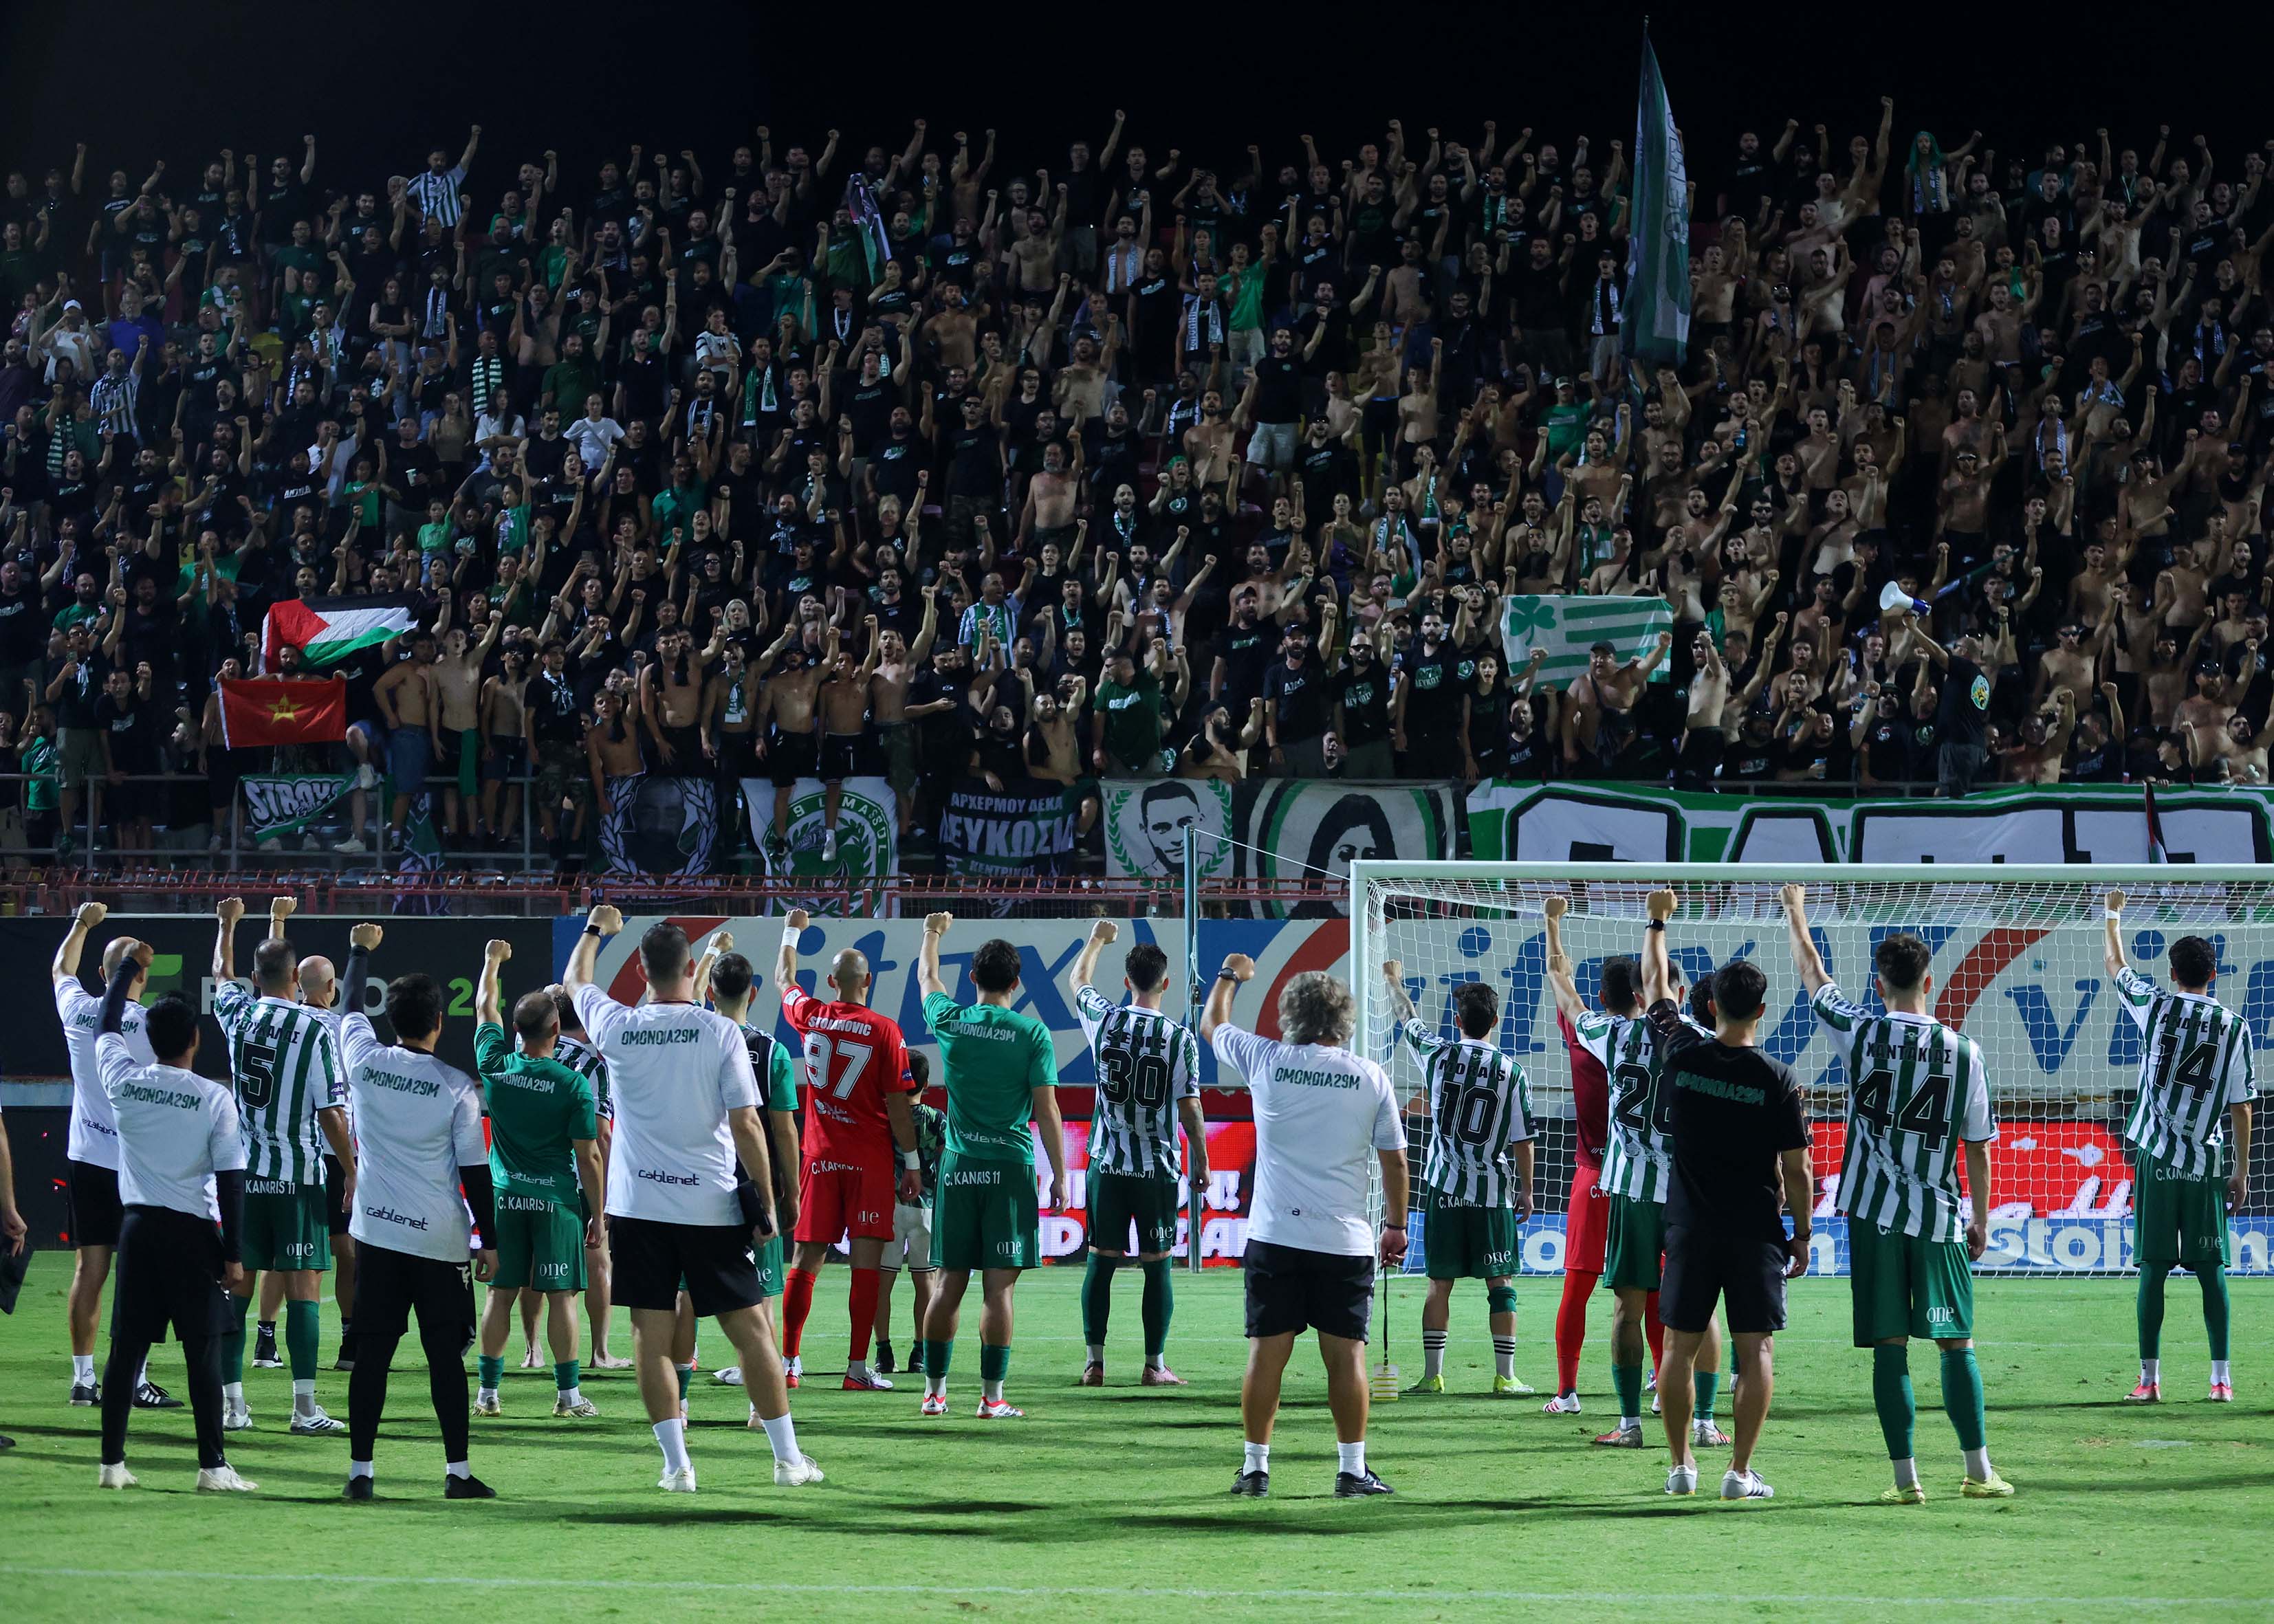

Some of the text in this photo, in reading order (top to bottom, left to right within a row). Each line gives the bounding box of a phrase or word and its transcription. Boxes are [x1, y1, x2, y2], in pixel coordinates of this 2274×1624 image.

[951, 792, 1027, 813] ΑΡΧΕΡΜΟΥ
[818, 796, 886, 855] LMASSOL
[808, 1015, 872, 1037] STOJANOVIC
[949, 1020, 1016, 1042] OMONOIA29M
[621, 1029, 699, 1046] OMONOIA29M
[804, 1029, 873, 1100] 97
[1438, 1059, 1506, 1082] MORAIS
[2151, 1031, 2220, 1103] 14
[239, 1041, 277, 1111] 5
[362, 1066, 441, 1098] OMONOIA29M
[1100, 1046, 1168, 1109] 30
[1274, 1067, 1361, 1090] OMONOIA29M
[122, 1084, 201, 1112] OMONOIA29M
[1675, 1071, 1765, 1106] OMONOIA29M
[1439, 1081, 1500, 1146] 10
[1854, 1068, 1953, 1152] 44
[638, 1170, 700, 1186] cablenet
[811, 1162, 820, 1174] C.
[2156, 1168, 2165, 1181] C.
[944, 1171, 1001, 1187] C. KANRIS 11
[498, 1196, 507, 1210] C.
[1439, 1196, 1447, 1209] C.
[367, 1205, 428, 1232] cablenet
[1150, 1226, 1173, 1239] one
[2199, 1236, 2222, 1249] one
[287, 1242, 314, 1256] one
[997, 1240, 1023, 1255] one
[1483, 1250, 1511, 1266] one
[539, 1262, 568, 1275] one
[1927, 1306, 1954, 1324] one
